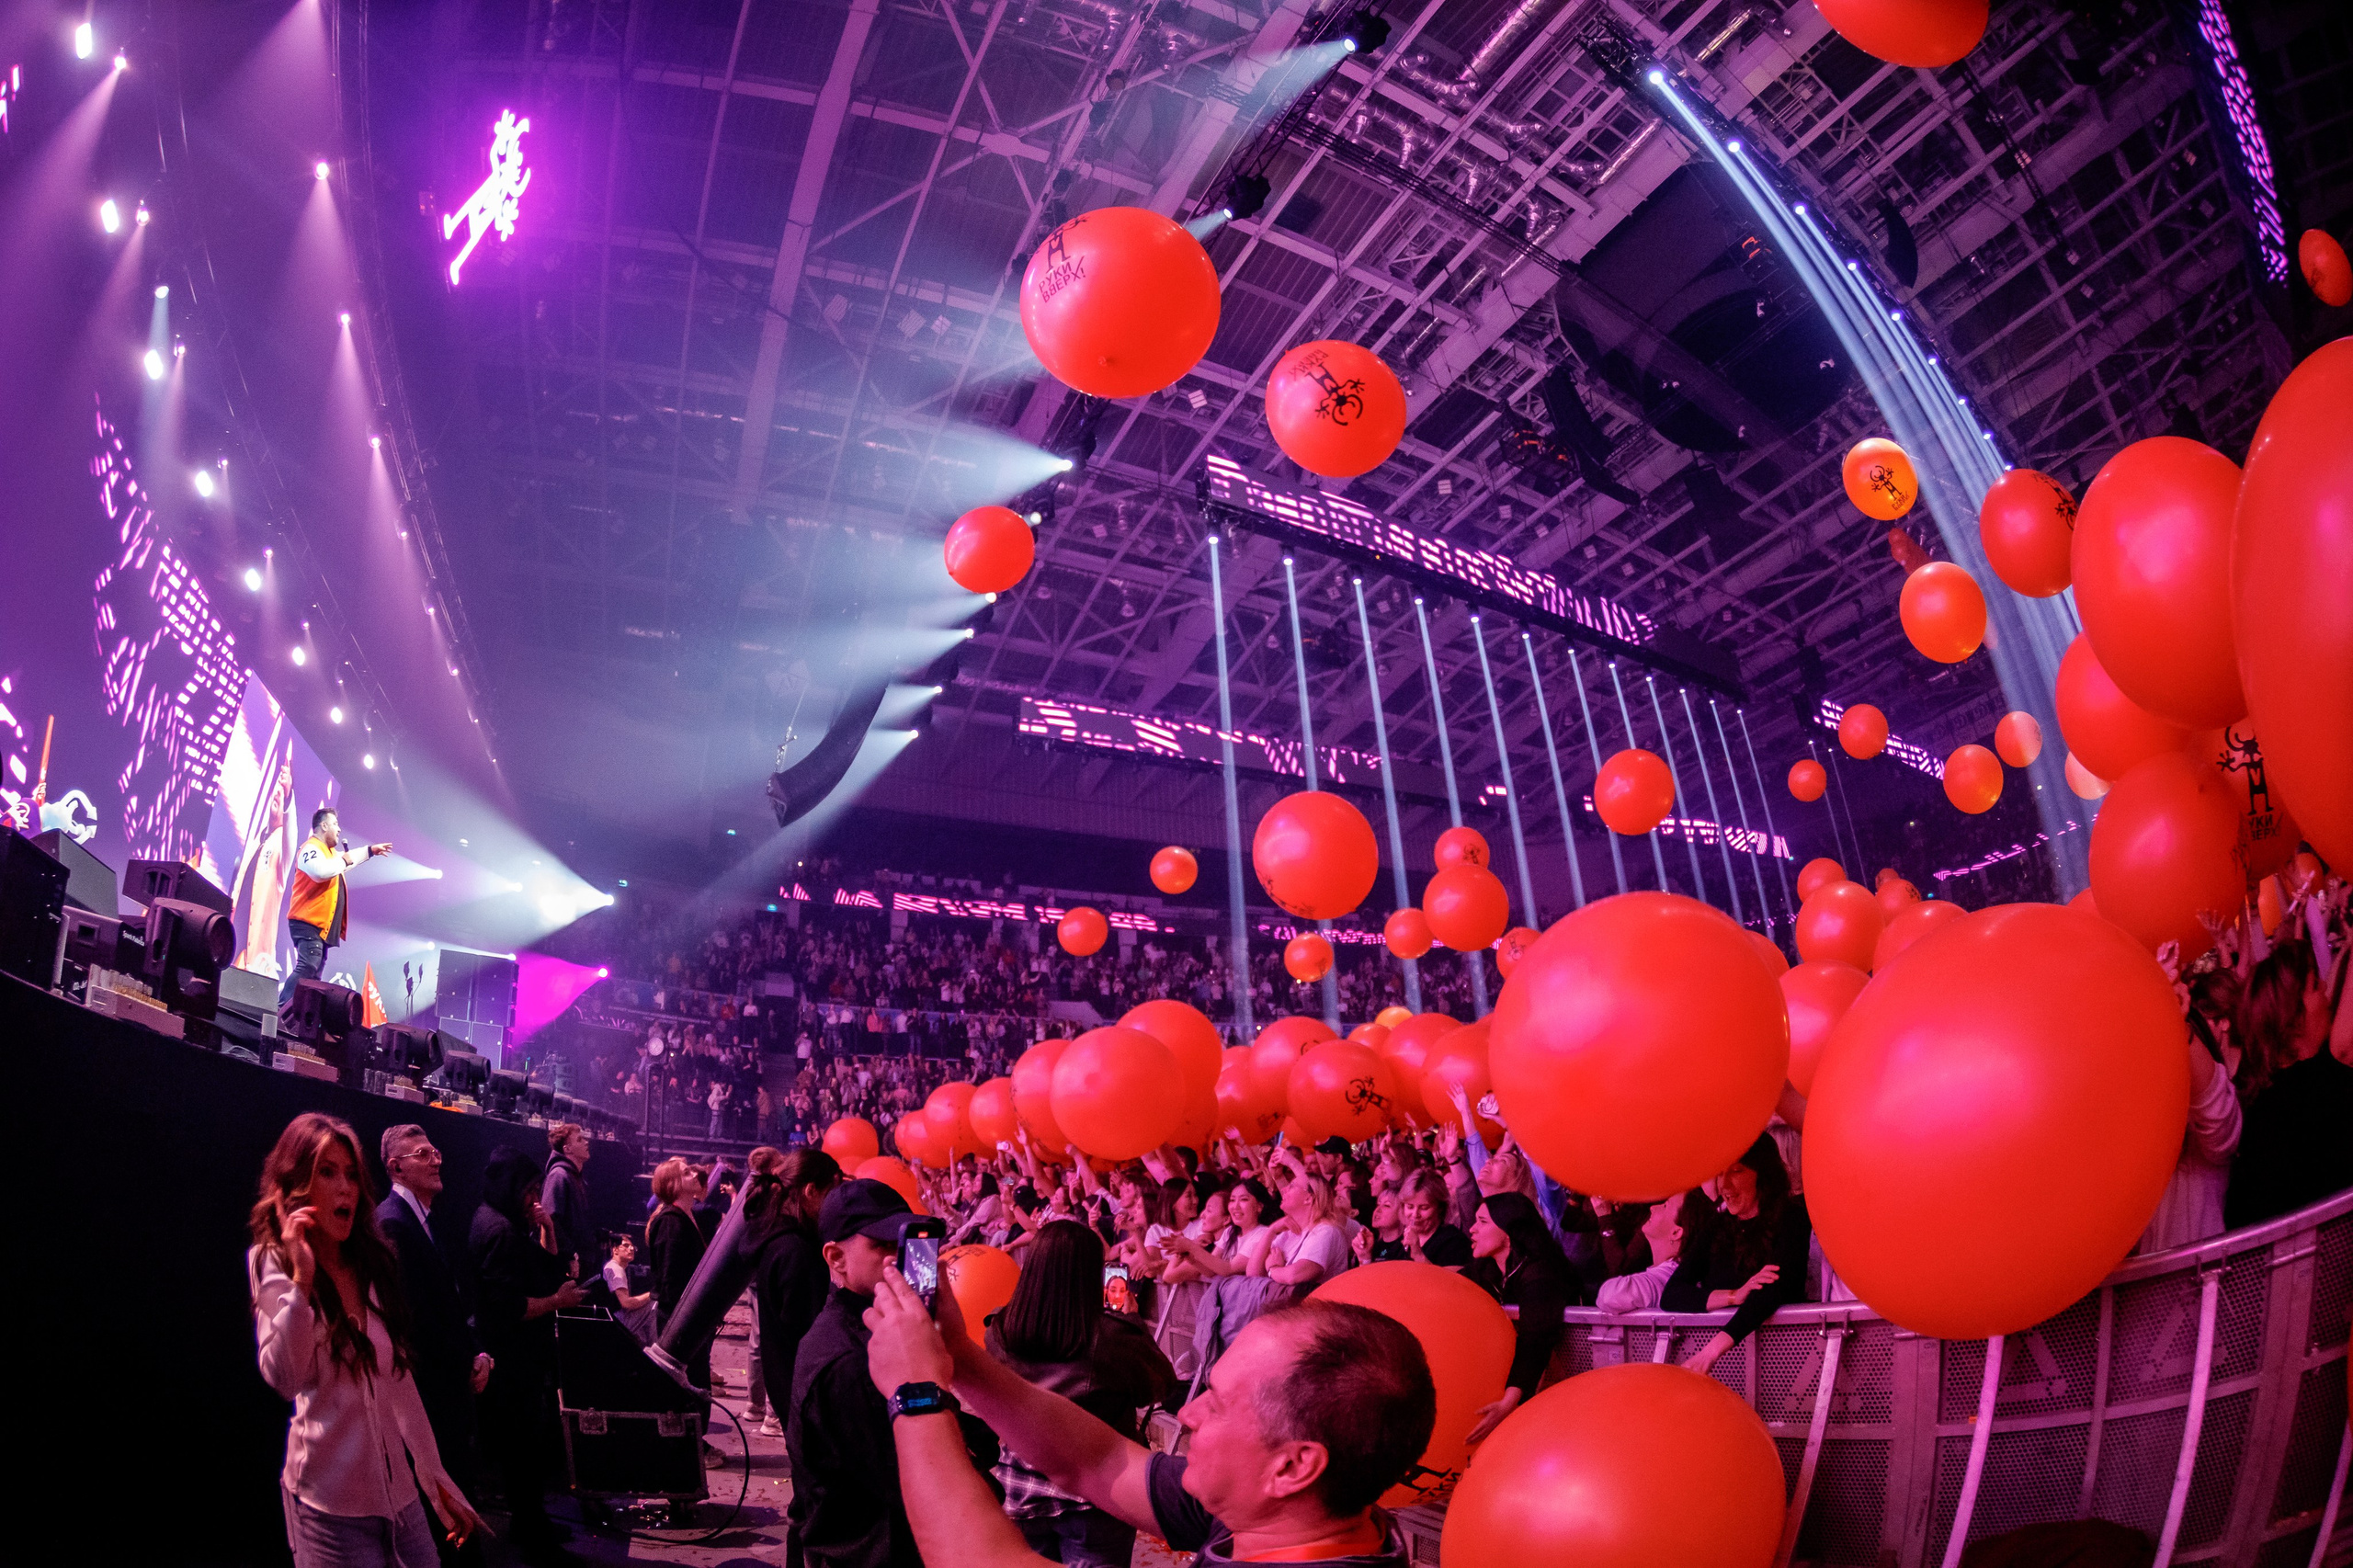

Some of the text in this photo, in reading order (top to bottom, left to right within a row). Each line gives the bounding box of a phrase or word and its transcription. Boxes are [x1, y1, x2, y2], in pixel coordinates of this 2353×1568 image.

[1039, 262, 1072, 293] РУКИ
[2248, 813, 2273, 828] УКИ
[302, 850, 317, 864] 22
